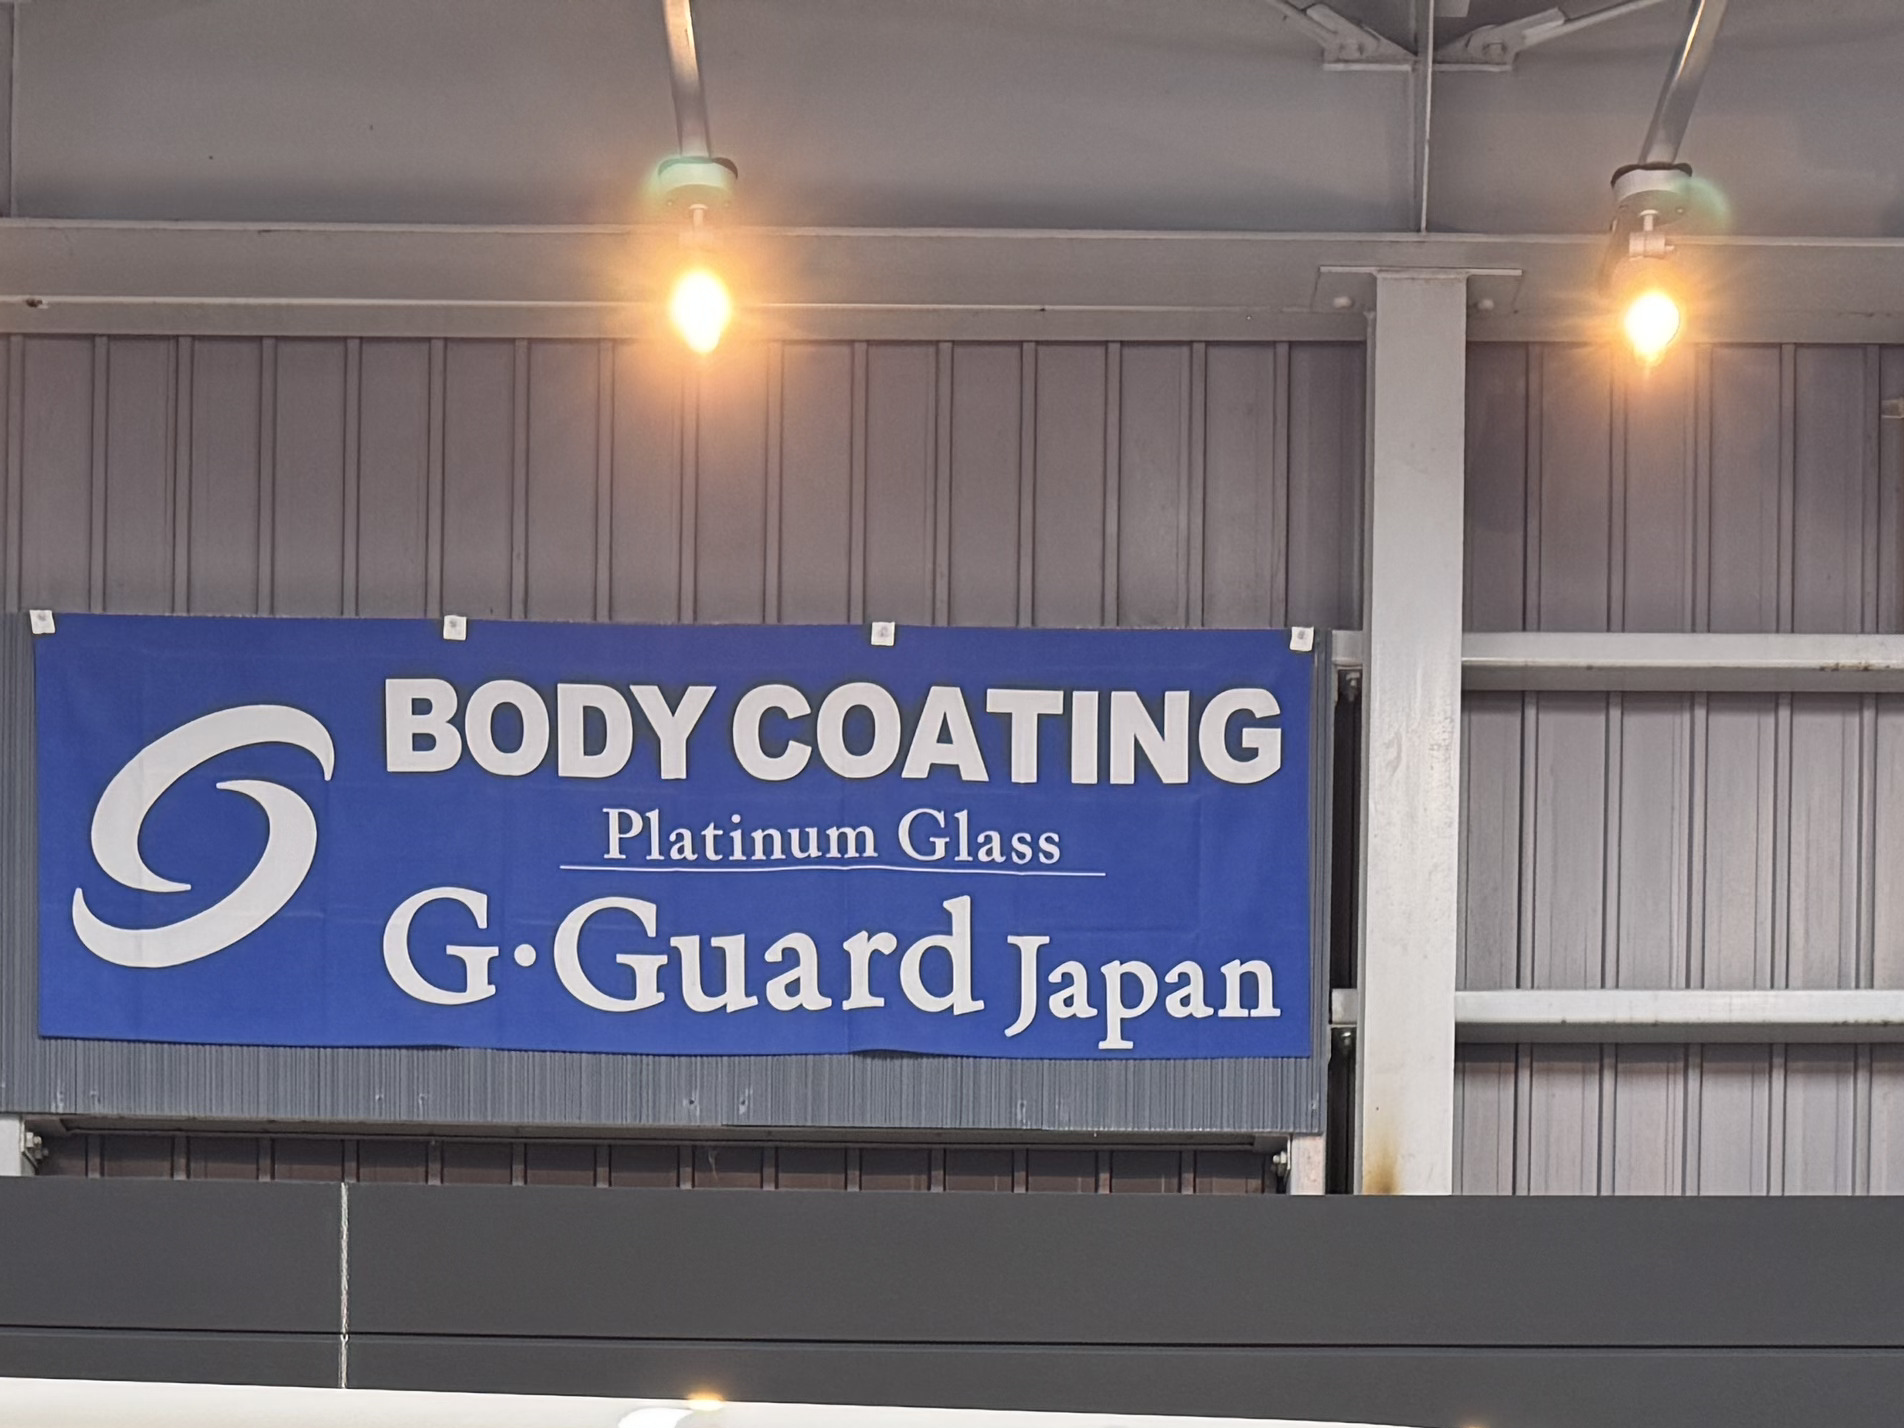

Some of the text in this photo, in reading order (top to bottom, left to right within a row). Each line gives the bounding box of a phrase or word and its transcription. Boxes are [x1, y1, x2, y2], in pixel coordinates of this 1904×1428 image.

[384, 677, 1283, 785] BODY COATING
[602, 807, 1062, 865] Platinum Glass
[1004, 934, 1282, 1050] Japan
